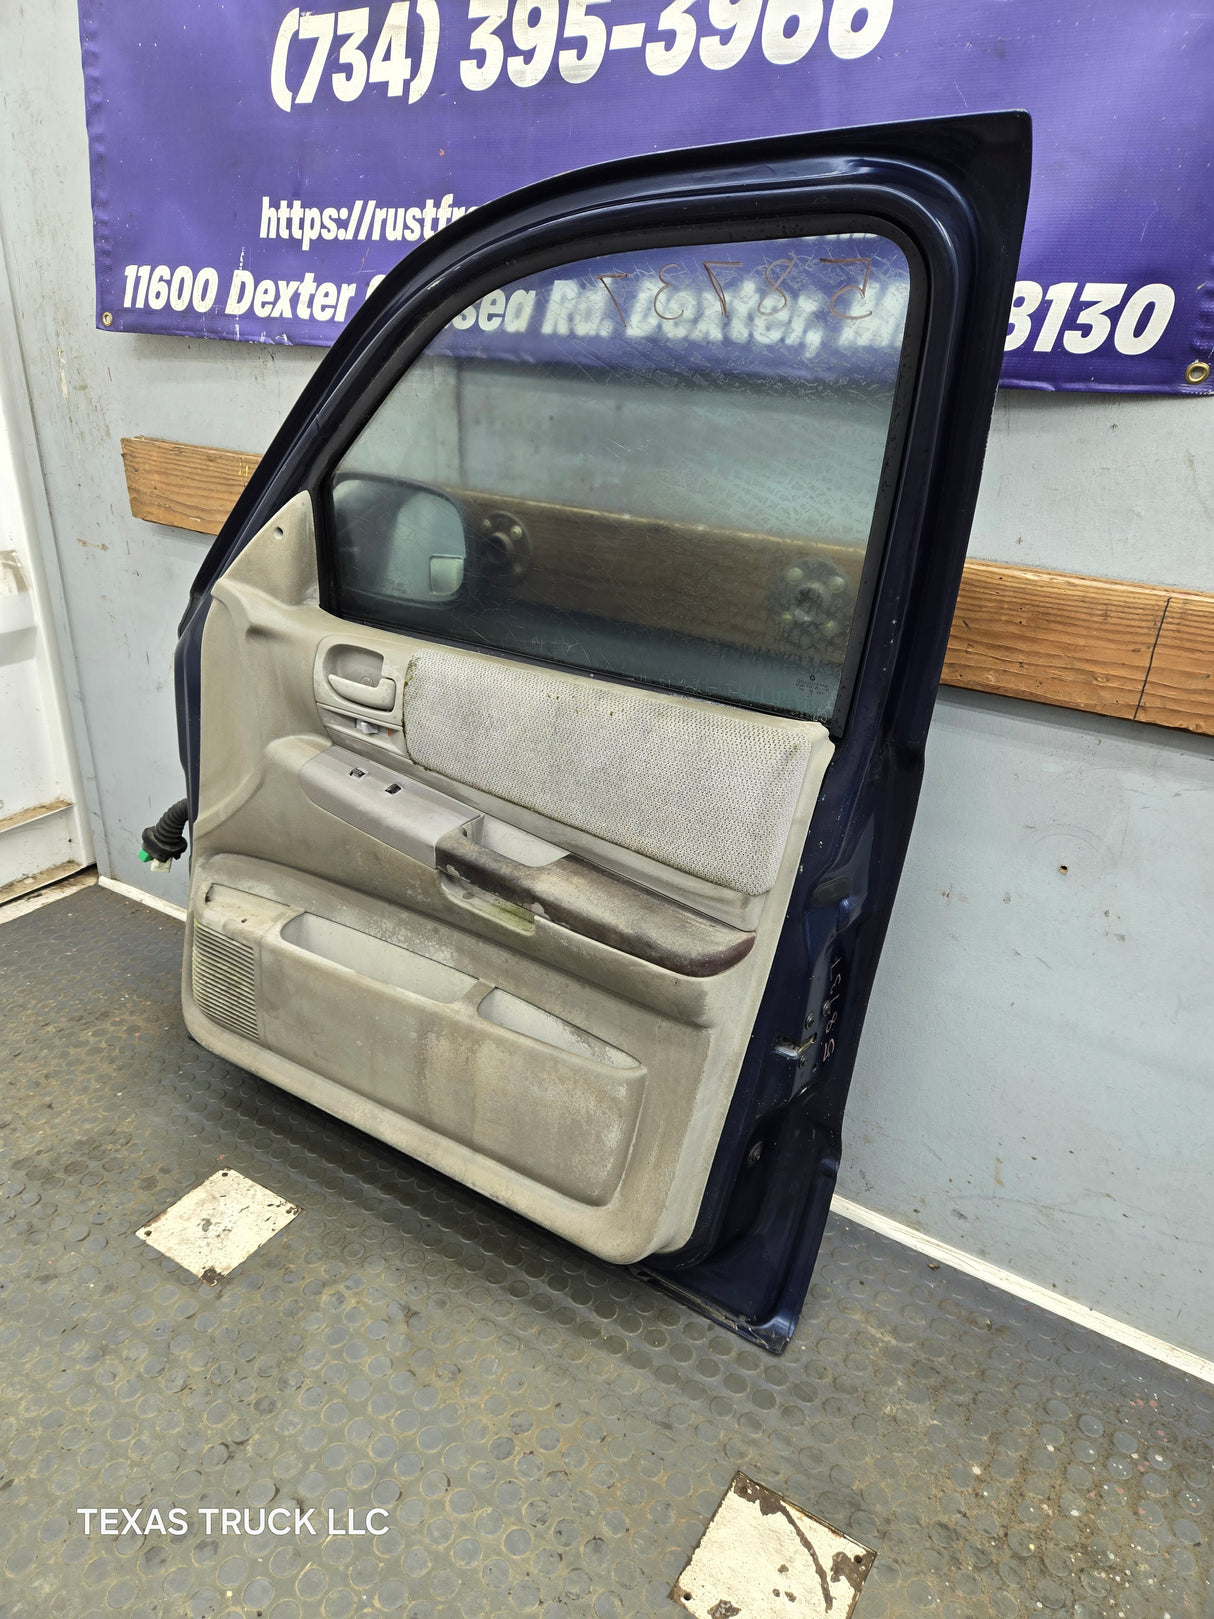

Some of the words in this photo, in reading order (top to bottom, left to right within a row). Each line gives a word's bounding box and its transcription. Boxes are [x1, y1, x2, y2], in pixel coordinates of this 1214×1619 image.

[271, 0, 440, 112] (734)
[459, 0, 893, 92] 395-3966
[123, 264, 219, 313] 11600
[224, 269, 356, 323] Dexter
[541, 279, 613, 338] Rd.
[626, 279, 822, 358] Dexter,
